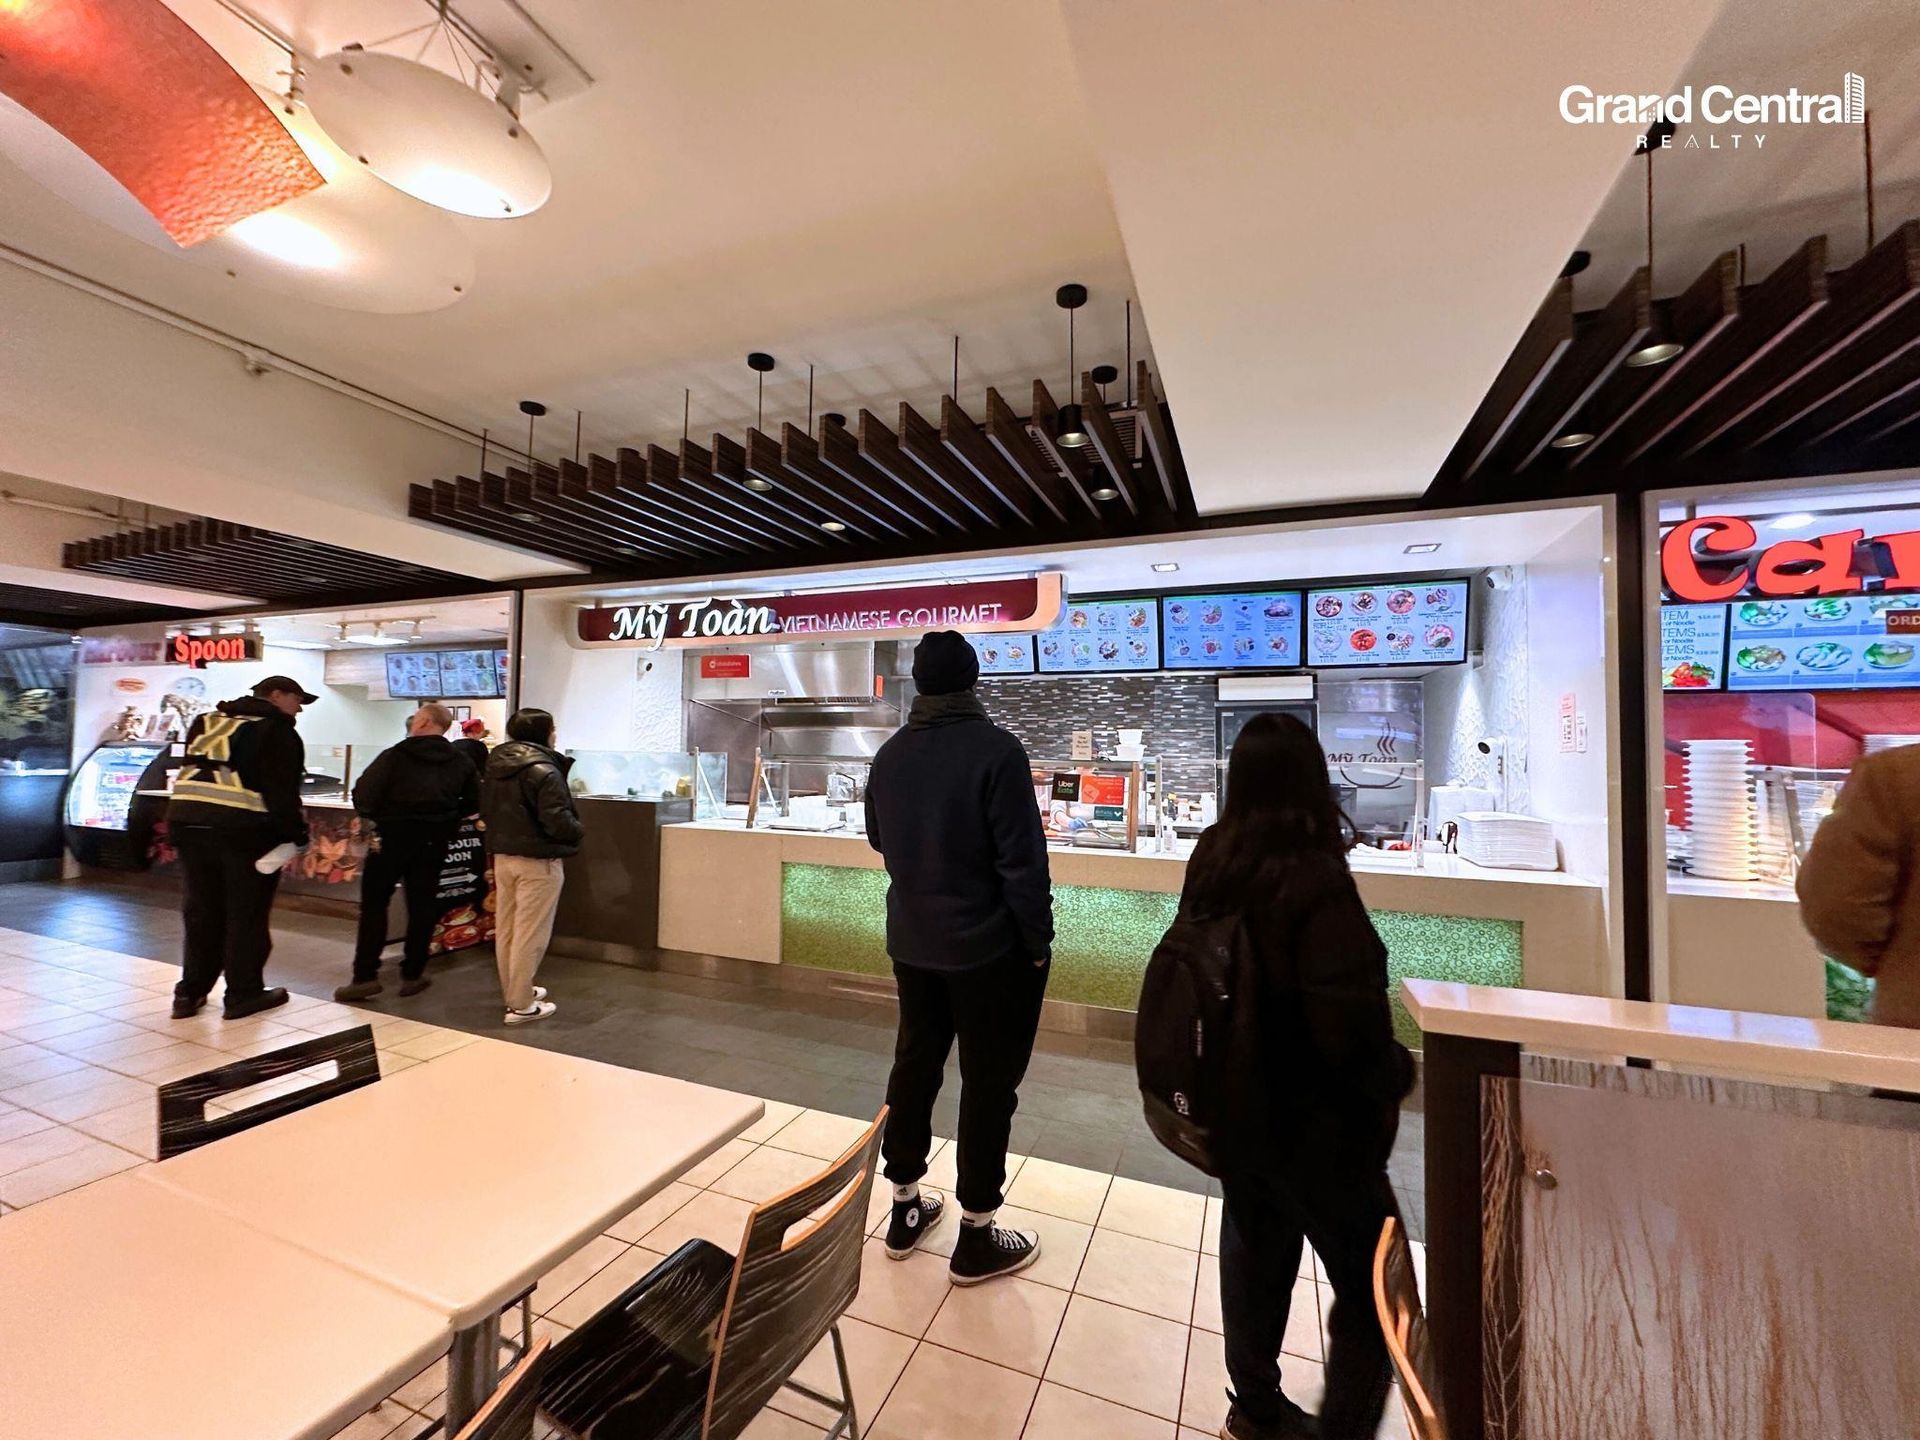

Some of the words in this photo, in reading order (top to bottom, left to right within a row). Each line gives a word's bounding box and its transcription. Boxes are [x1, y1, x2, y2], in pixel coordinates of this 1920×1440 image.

[609, 601, 669, 651] Mỹ
[679, 597, 777, 637] Toàn
[778, 609, 891, 634] VIETNAMESE
[897, 603, 1002, 628] GOURMET
[175, 634, 246, 669] Spoon
[1057, 780, 1075, 788] Uber
